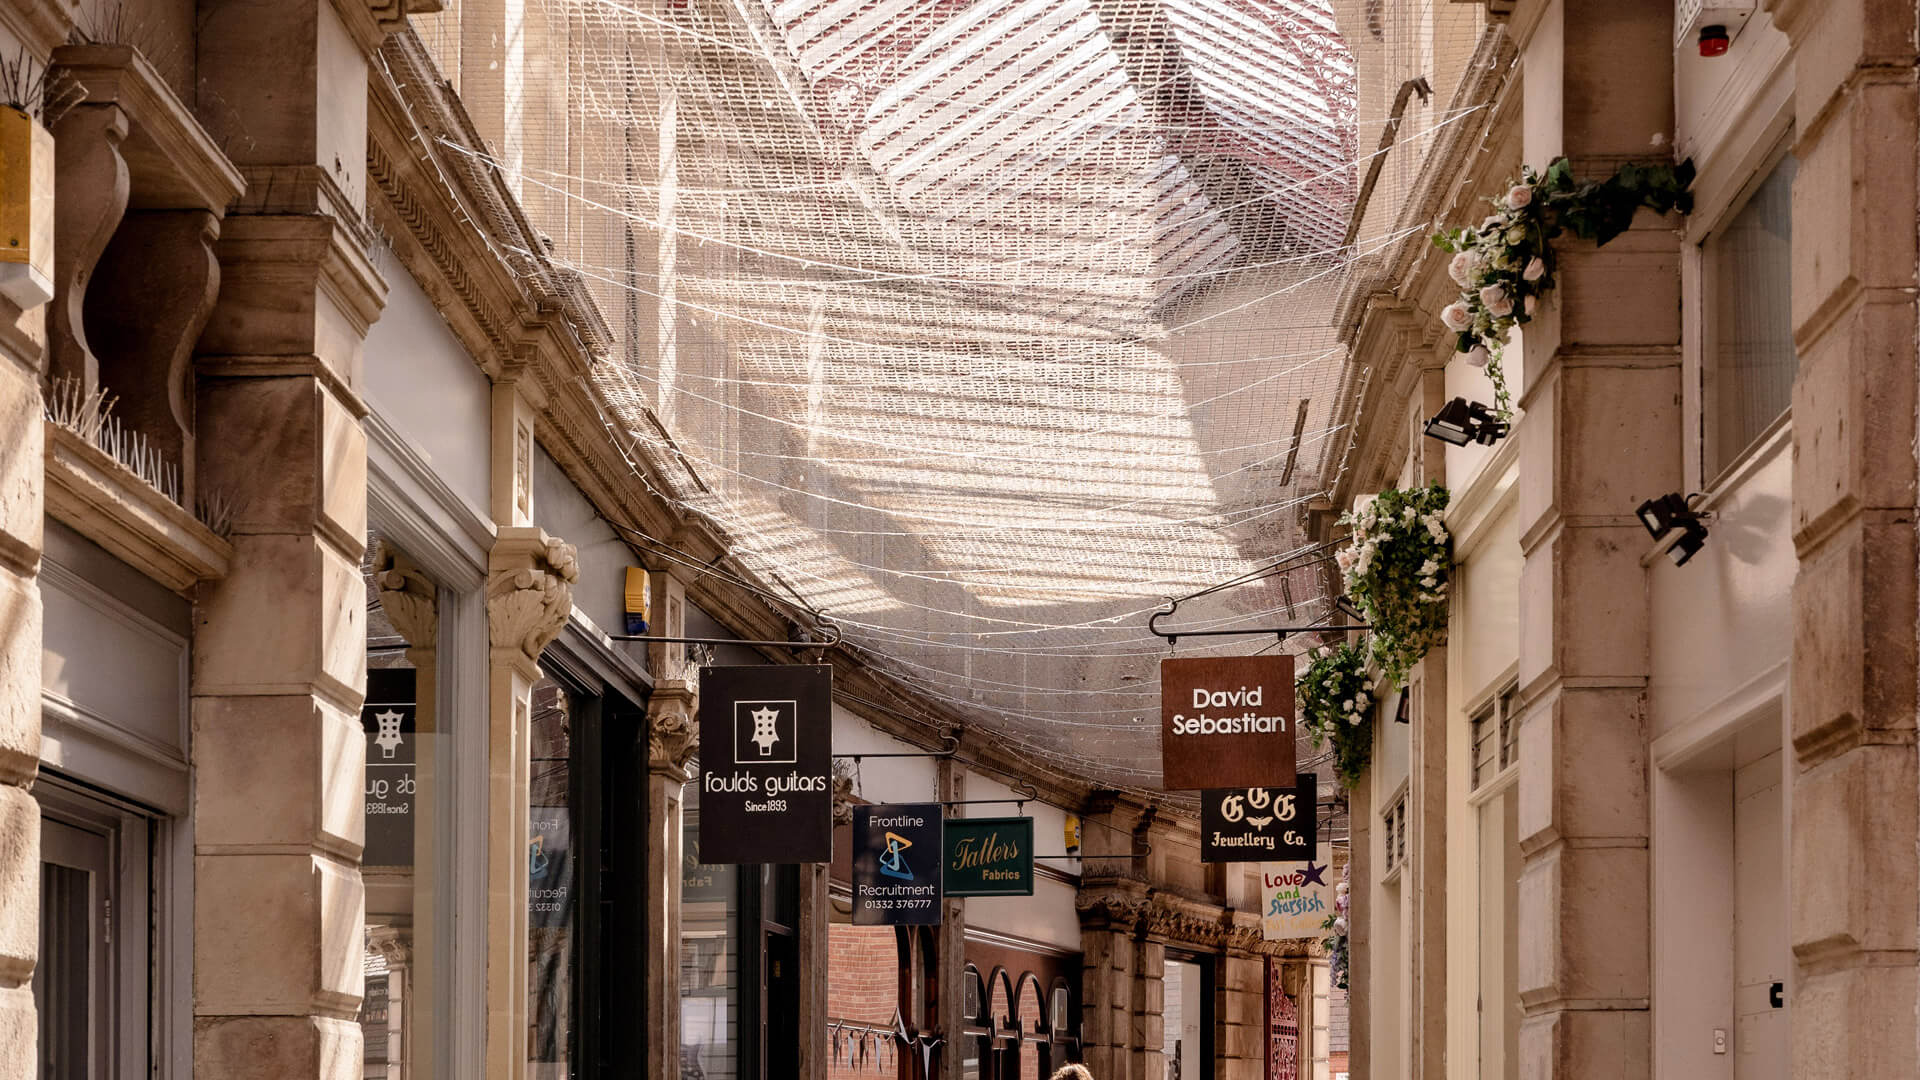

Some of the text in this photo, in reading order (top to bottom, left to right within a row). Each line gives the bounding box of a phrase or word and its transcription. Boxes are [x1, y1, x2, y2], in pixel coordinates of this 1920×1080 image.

[1192, 685, 1262, 708] David
[1172, 712, 1286, 735] Sebastian
[705, 770, 826, 797] foulds guitars
[869, 815, 924, 828] Frontline
[1211, 830, 1308, 850] Jewellery Co.
[982, 869, 1020, 881] Fabrics
[1264, 873, 1303, 889] Love
[859, 884, 935, 897] Recruitment
[1276, 886, 1301, 900] and
[864, 899, 932, 910] 01332 376777
[1267, 890, 1326, 917] Starfish
